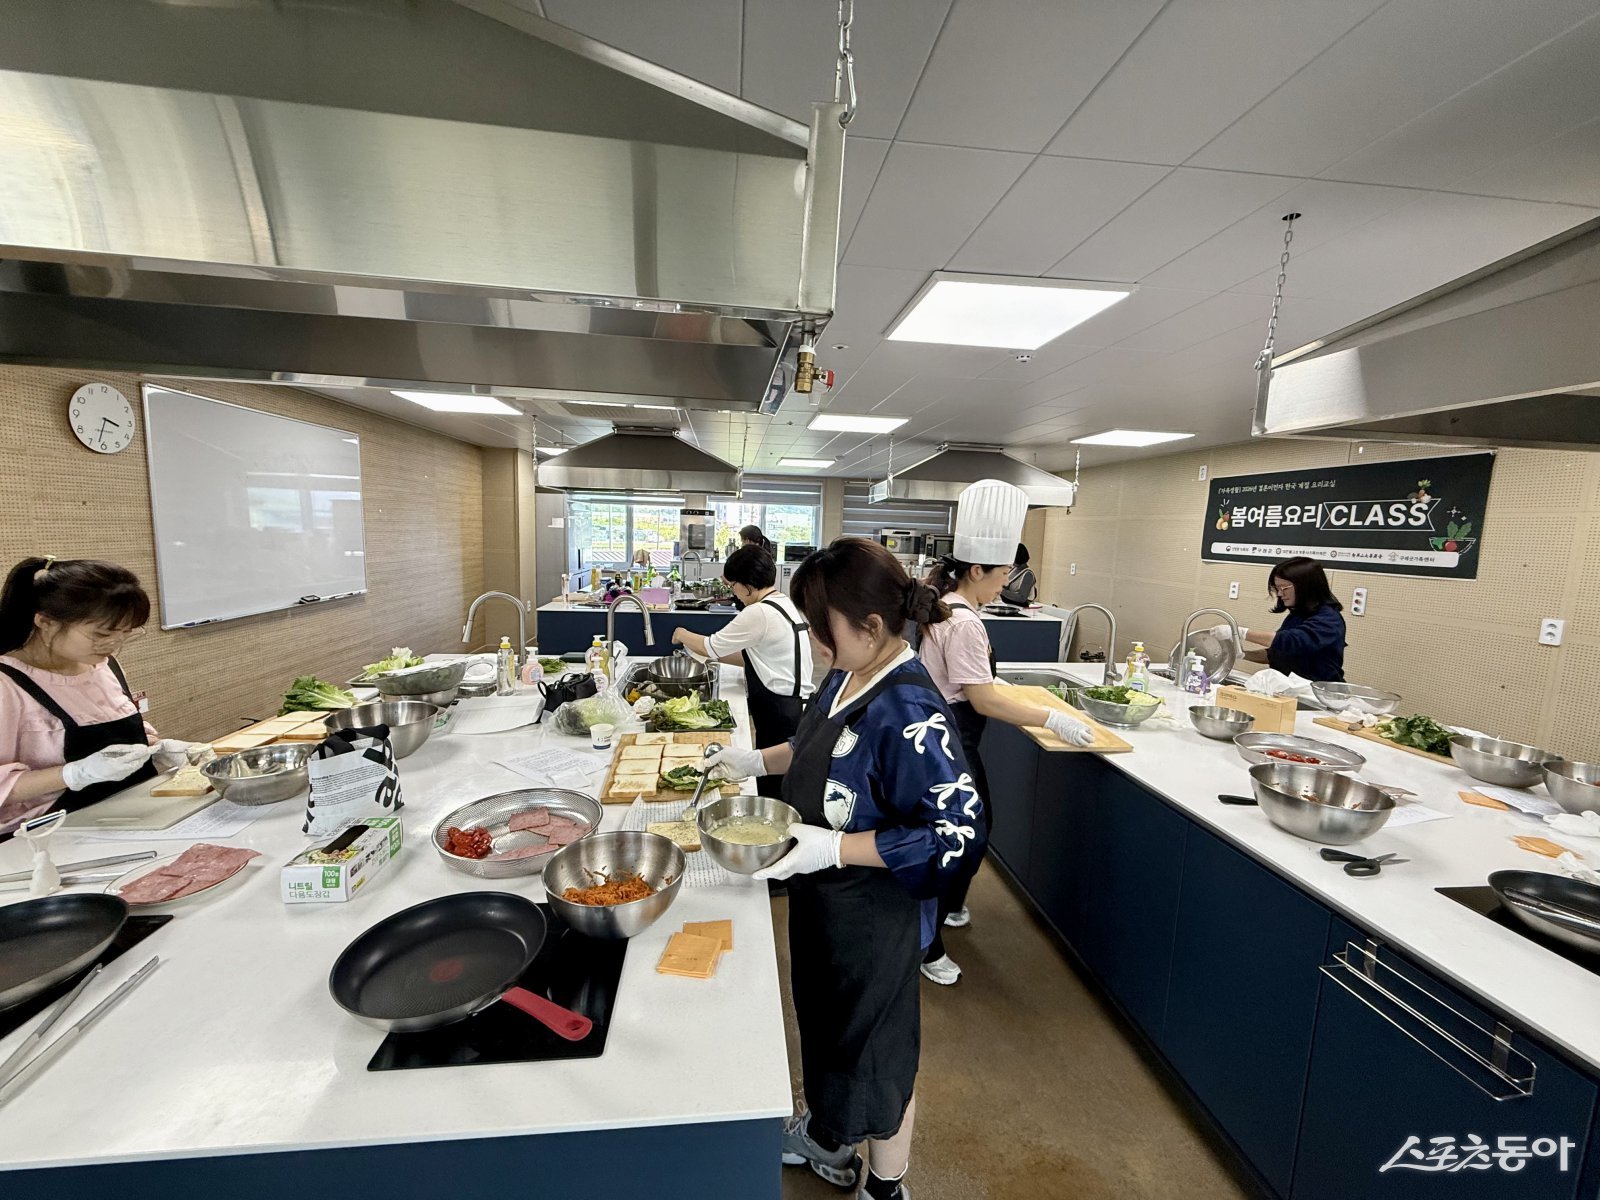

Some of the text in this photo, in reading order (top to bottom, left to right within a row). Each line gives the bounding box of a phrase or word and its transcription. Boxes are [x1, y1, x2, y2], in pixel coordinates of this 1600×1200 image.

[77, 396, 86, 404] 10
[72, 409, 80, 418] 9
[77, 425, 84, 434] 8
[100, 441, 107, 450] 6
[1285, 482, 1297, 491] 한국
[1310, 479, 1336, 489] 요리교실
[1231, 503, 1429, 528] 봄여름요리 CLASS
[288, 882, 313, 890] 니트릴
[289, 890, 330, 898] 다용도장갑
